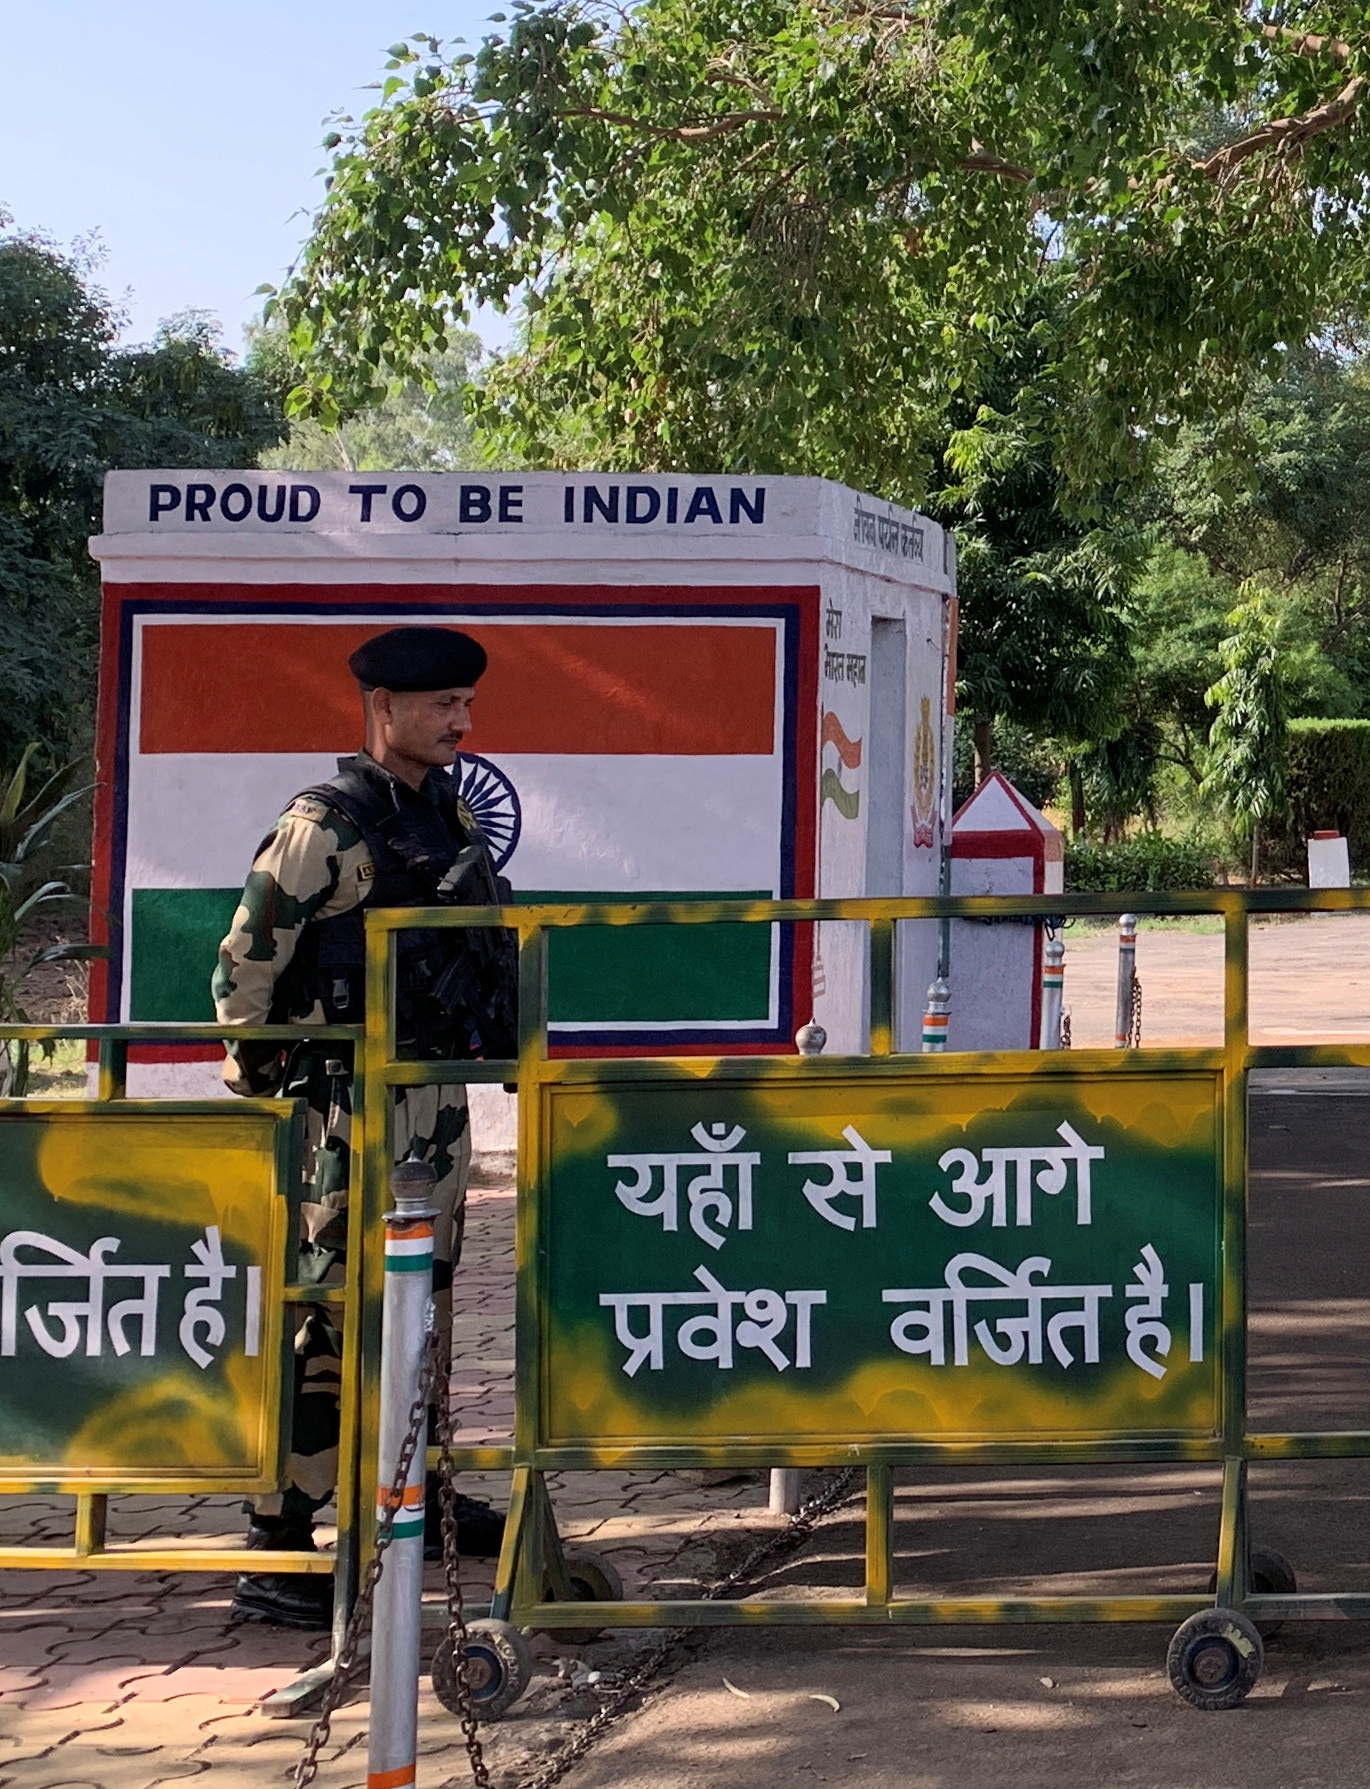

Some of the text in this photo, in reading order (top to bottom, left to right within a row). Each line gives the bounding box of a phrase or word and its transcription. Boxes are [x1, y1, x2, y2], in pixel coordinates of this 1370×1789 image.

[149, 483, 766, 525] PROUD TO BE INDIAN
[608, 1120, 1105, 1250] यहाँ से आगे
[0, 1230, 171, 1358] र्जित
[600, 1265, 827, 1378] प्रवेश
[882, 1252, 1113, 1370] वर्जित
